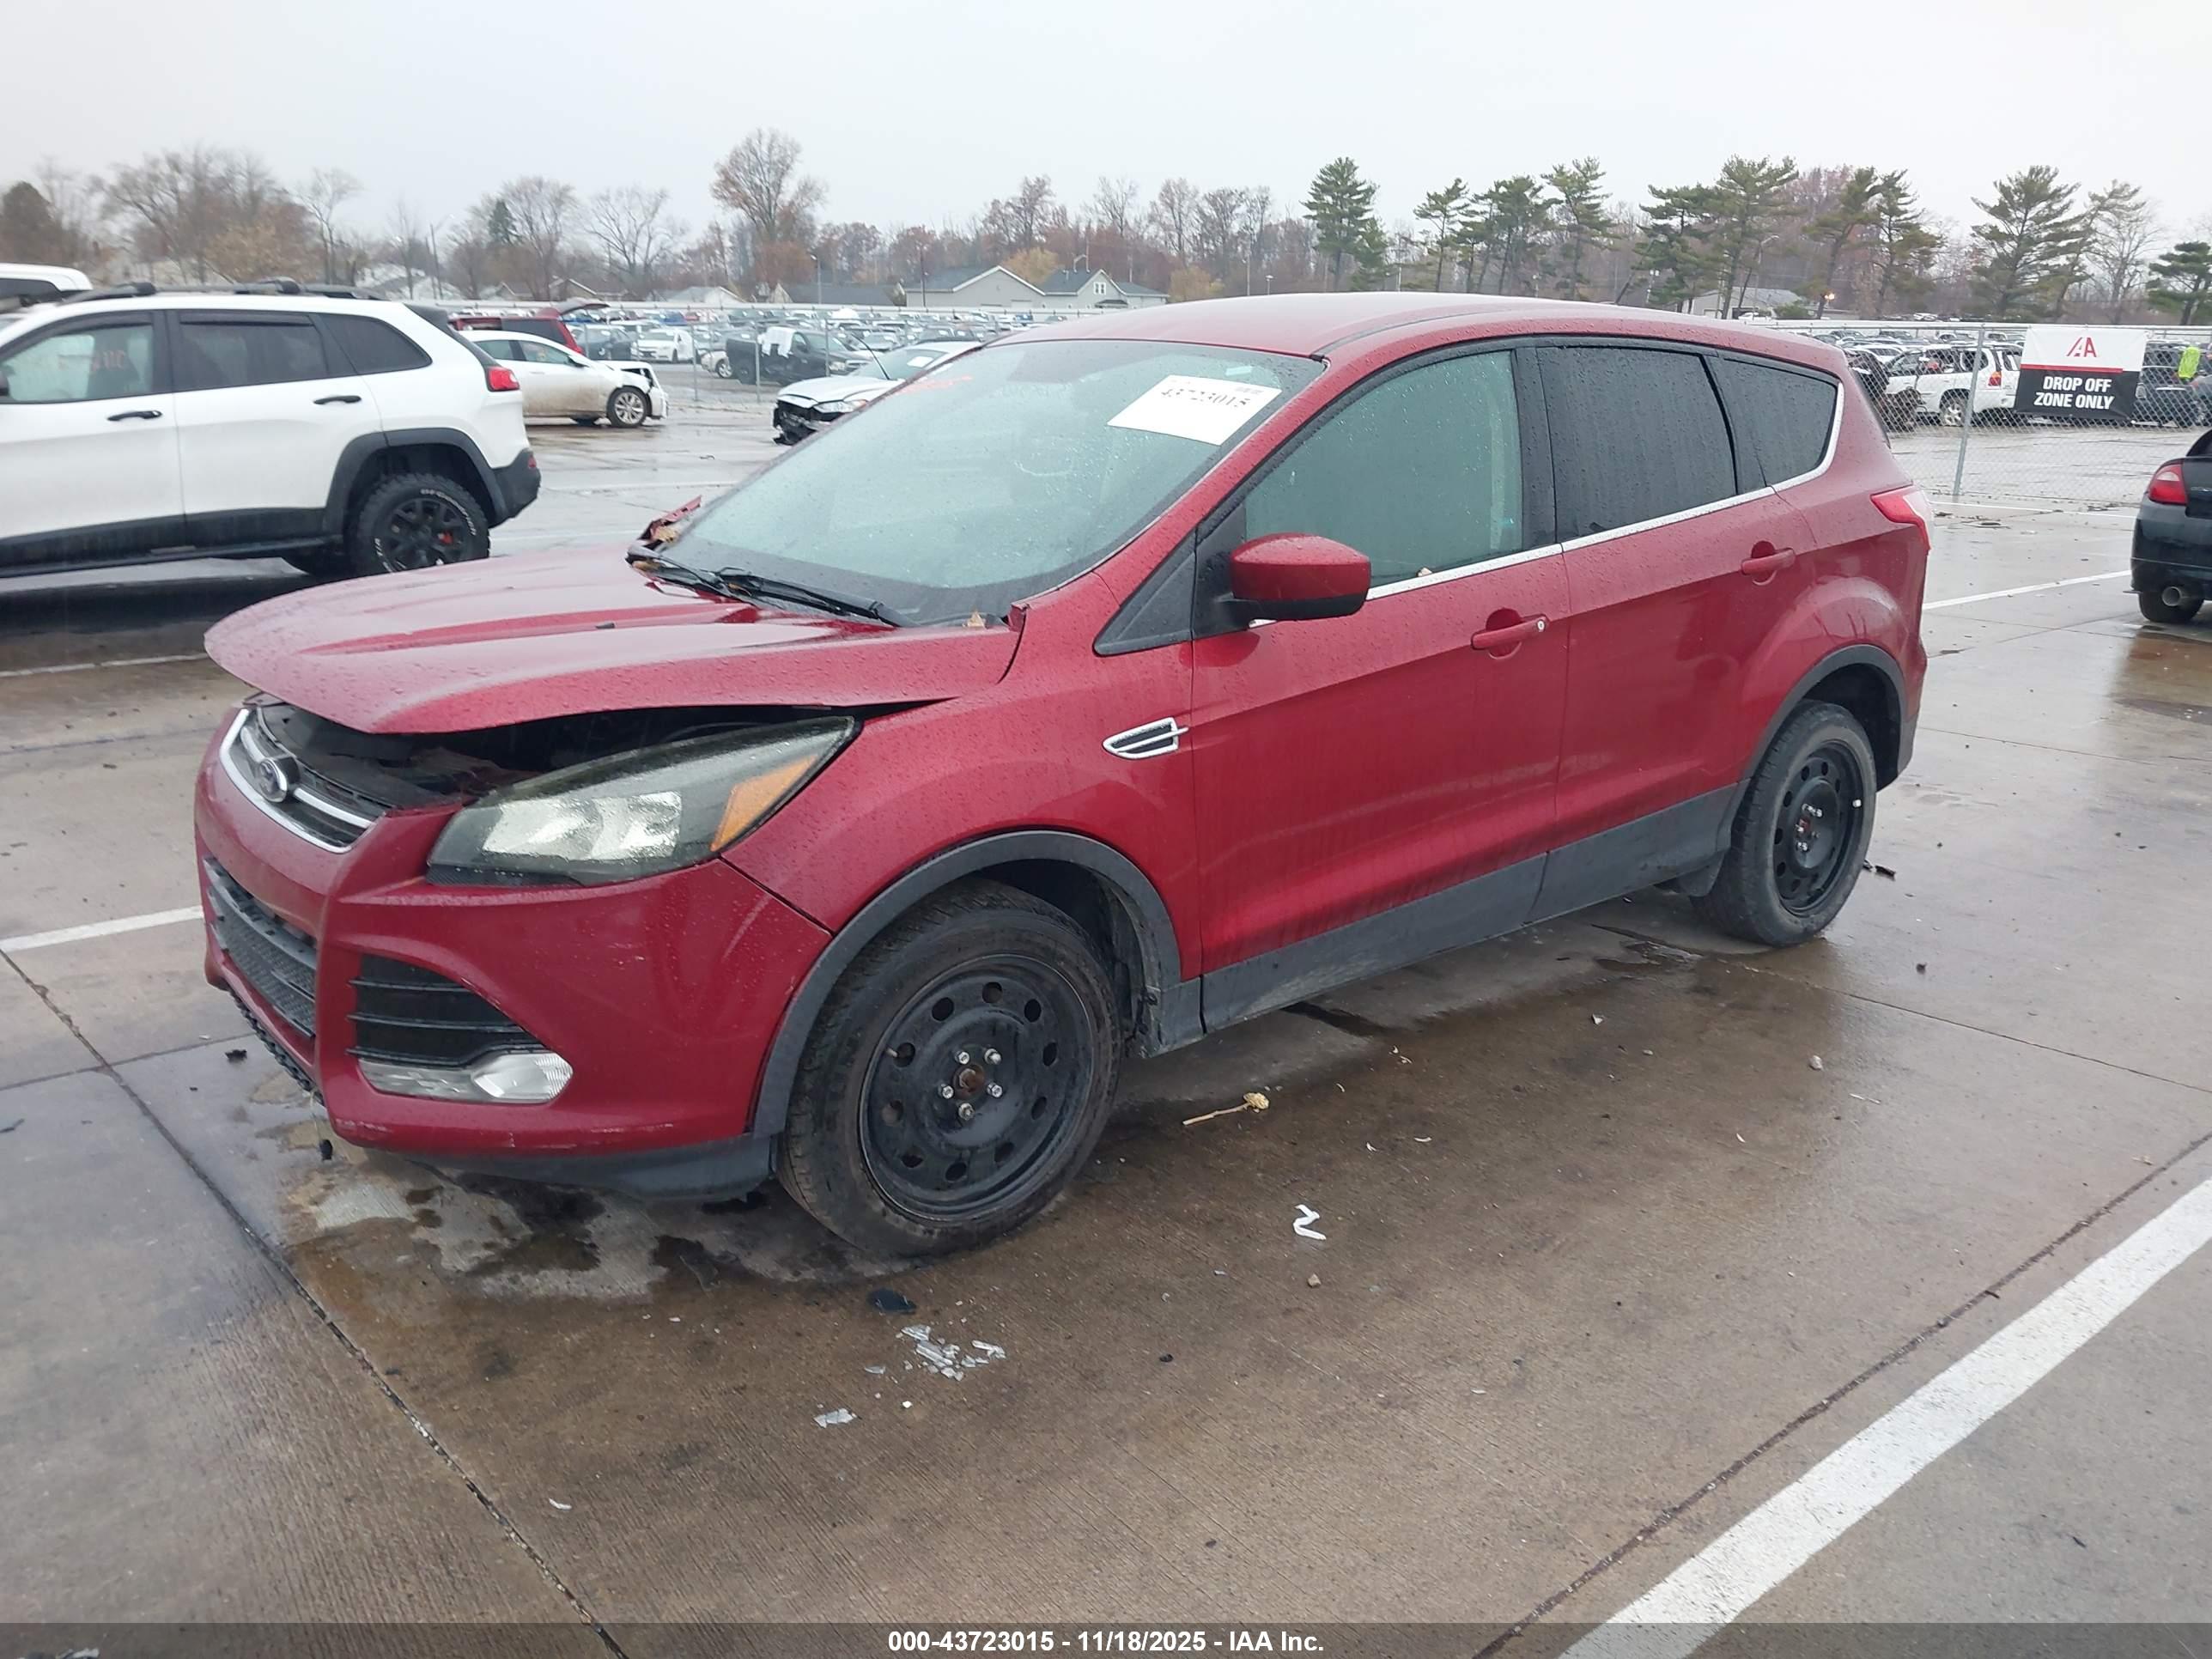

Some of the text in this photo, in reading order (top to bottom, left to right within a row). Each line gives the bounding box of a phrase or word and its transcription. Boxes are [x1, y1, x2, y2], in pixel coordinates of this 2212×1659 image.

[2043, 376, 2112, 392] DROP OFF
[2033, 392, 2115, 410] ZONE ONLY
